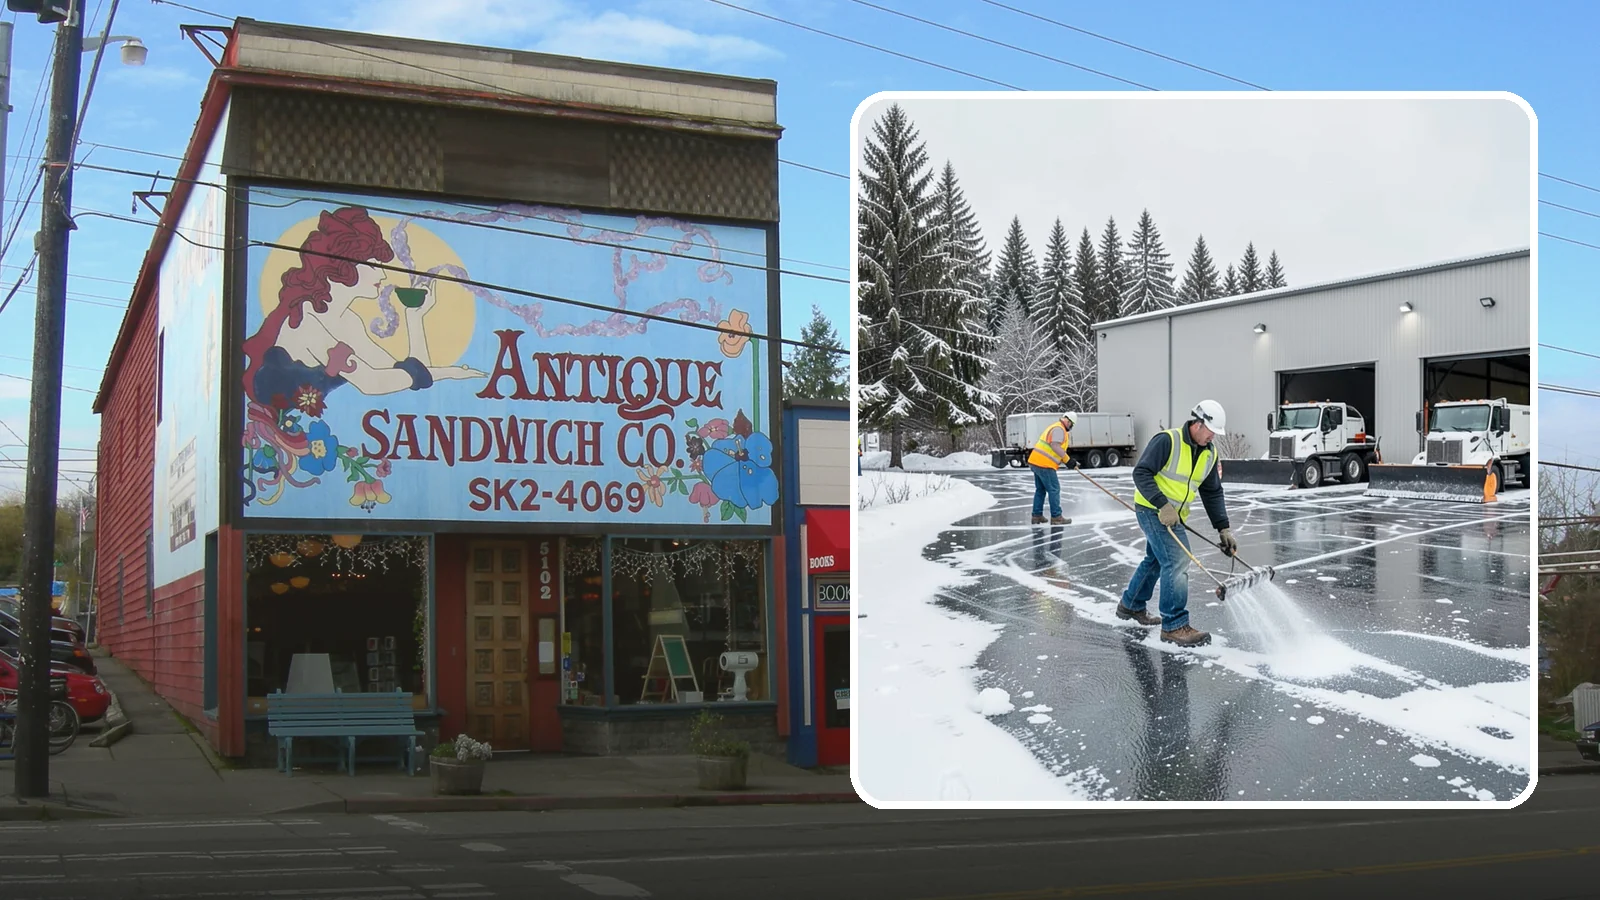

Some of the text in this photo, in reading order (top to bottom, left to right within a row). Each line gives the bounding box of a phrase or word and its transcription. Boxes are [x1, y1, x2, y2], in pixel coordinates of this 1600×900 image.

[476, 329, 723, 421] ANTIQUE
[361, 409, 685, 468] SANDWICH CO.
[469, 478, 645, 513] SK2-4069
[539, 541, 552, 600] 5102
[809, 555, 834, 569] BOOKS
